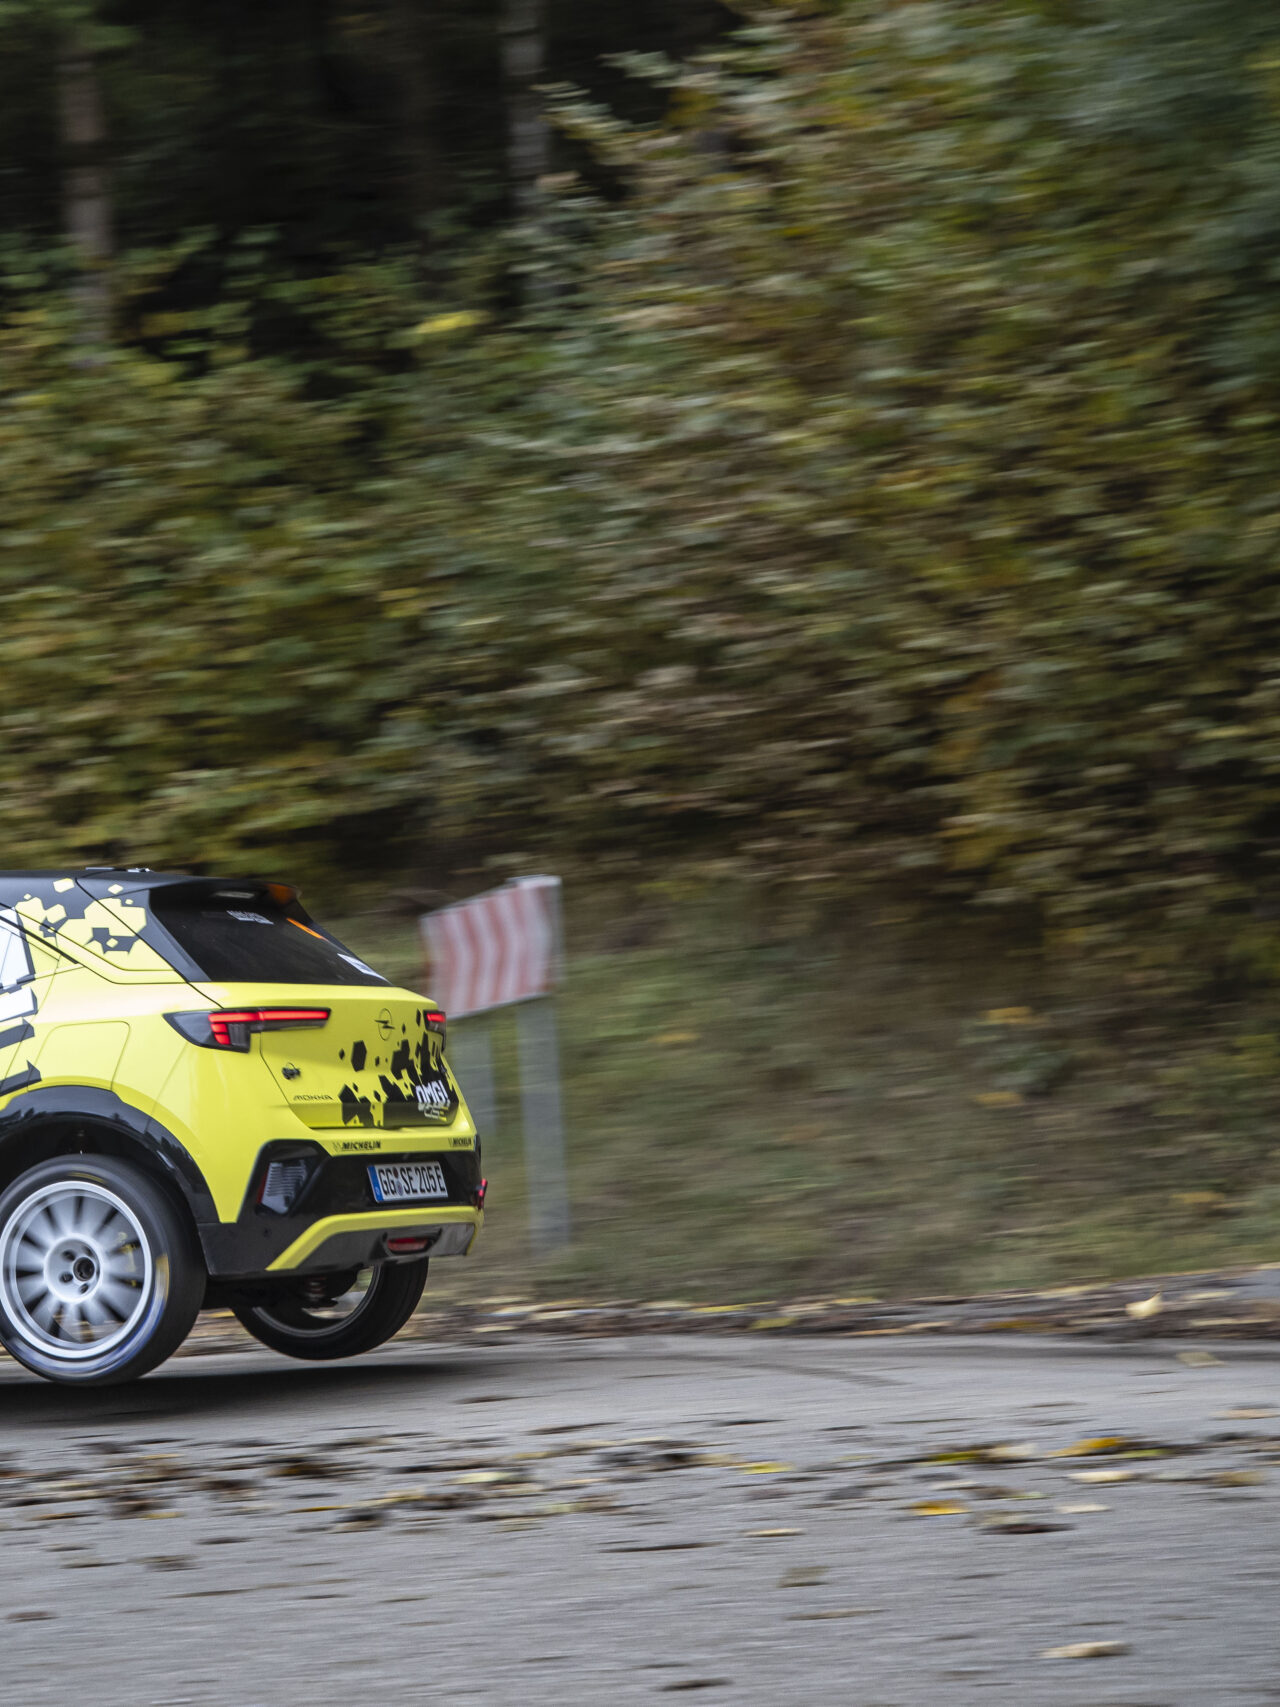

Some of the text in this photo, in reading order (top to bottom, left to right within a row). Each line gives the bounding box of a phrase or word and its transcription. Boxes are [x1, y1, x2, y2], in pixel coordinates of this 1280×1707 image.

[342, 1141, 381, 1151] MICHELIN
[378, 1168, 398, 1195] GG
[400, 1167, 418, 1194] SE
